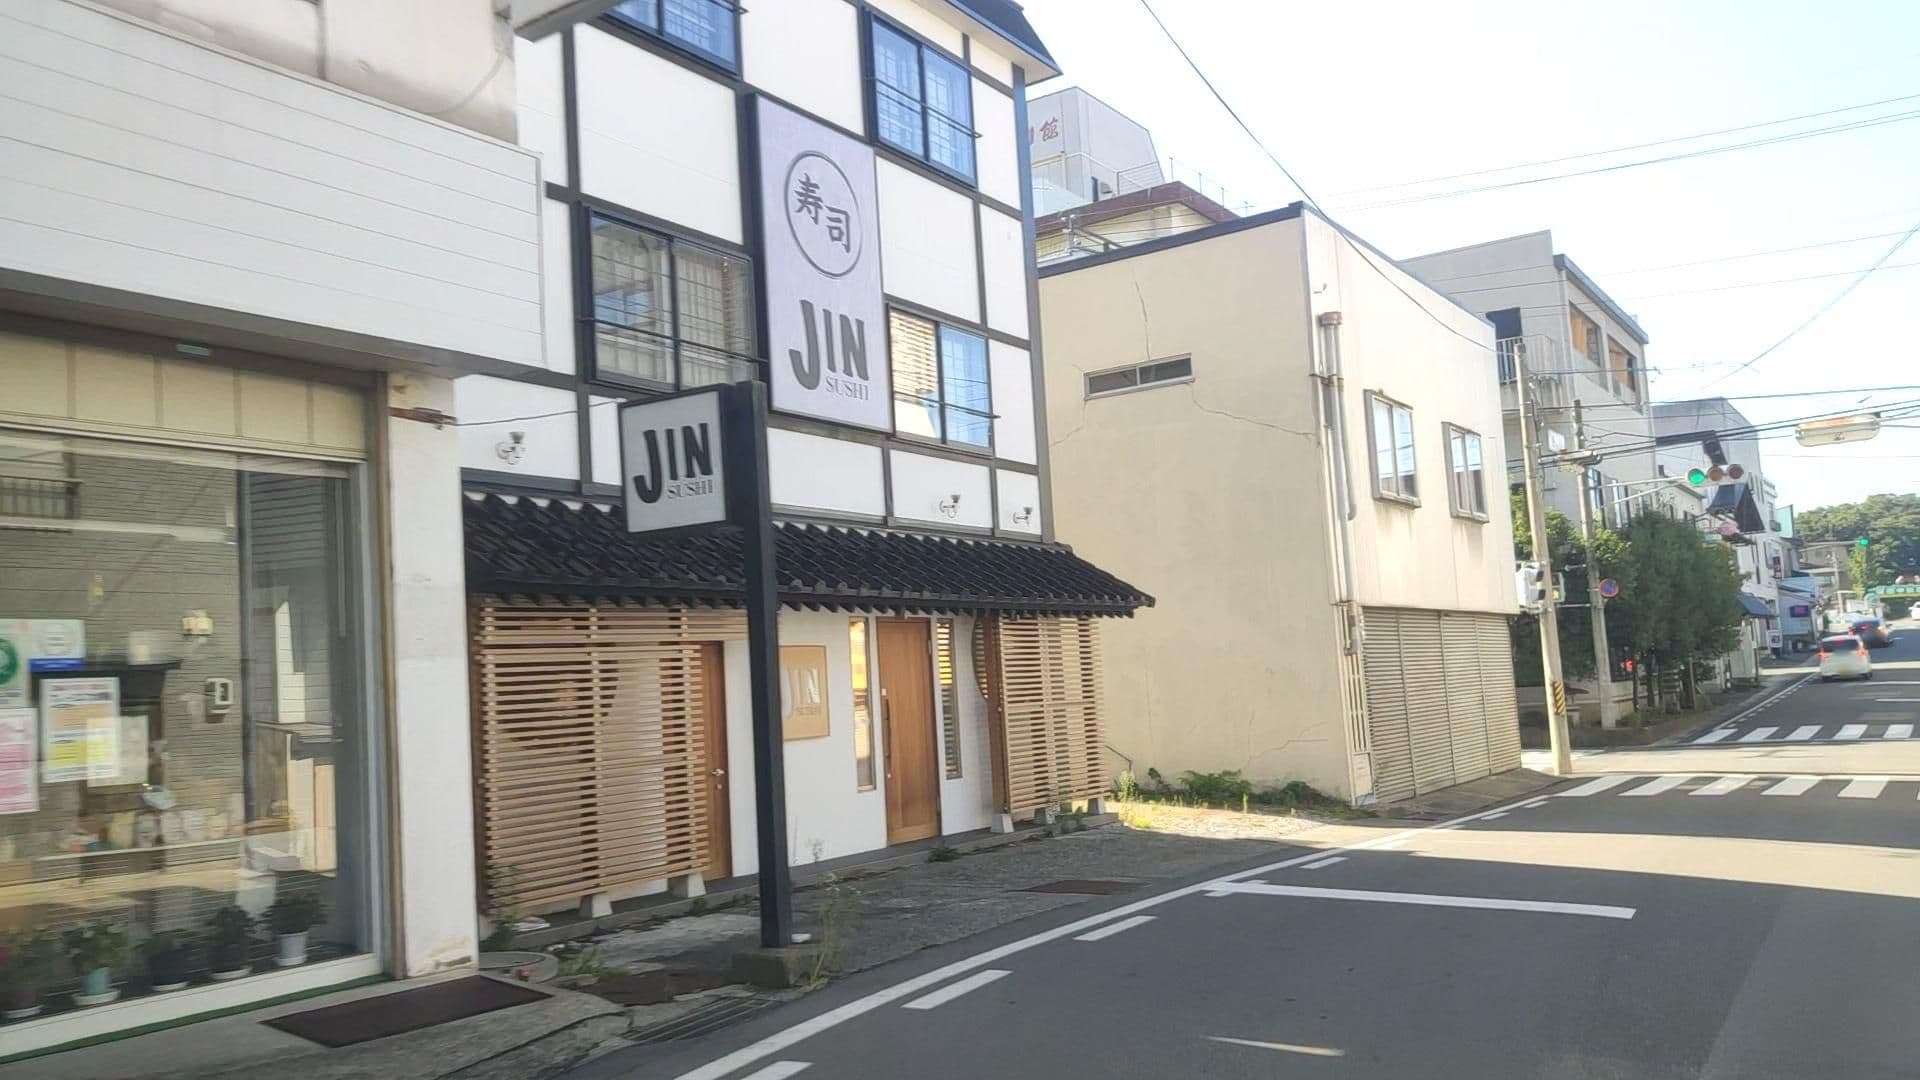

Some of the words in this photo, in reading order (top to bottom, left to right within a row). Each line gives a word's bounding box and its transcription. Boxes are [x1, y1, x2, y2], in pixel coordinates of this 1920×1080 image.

[794, 172, 850, 253] 寿司
[788, 299, 869, 390] JIN
[825, 376, 869, 400] SUSHI
[633, 423, 713, 503] JIN
[667, 480, 713, 499] SUSHI
